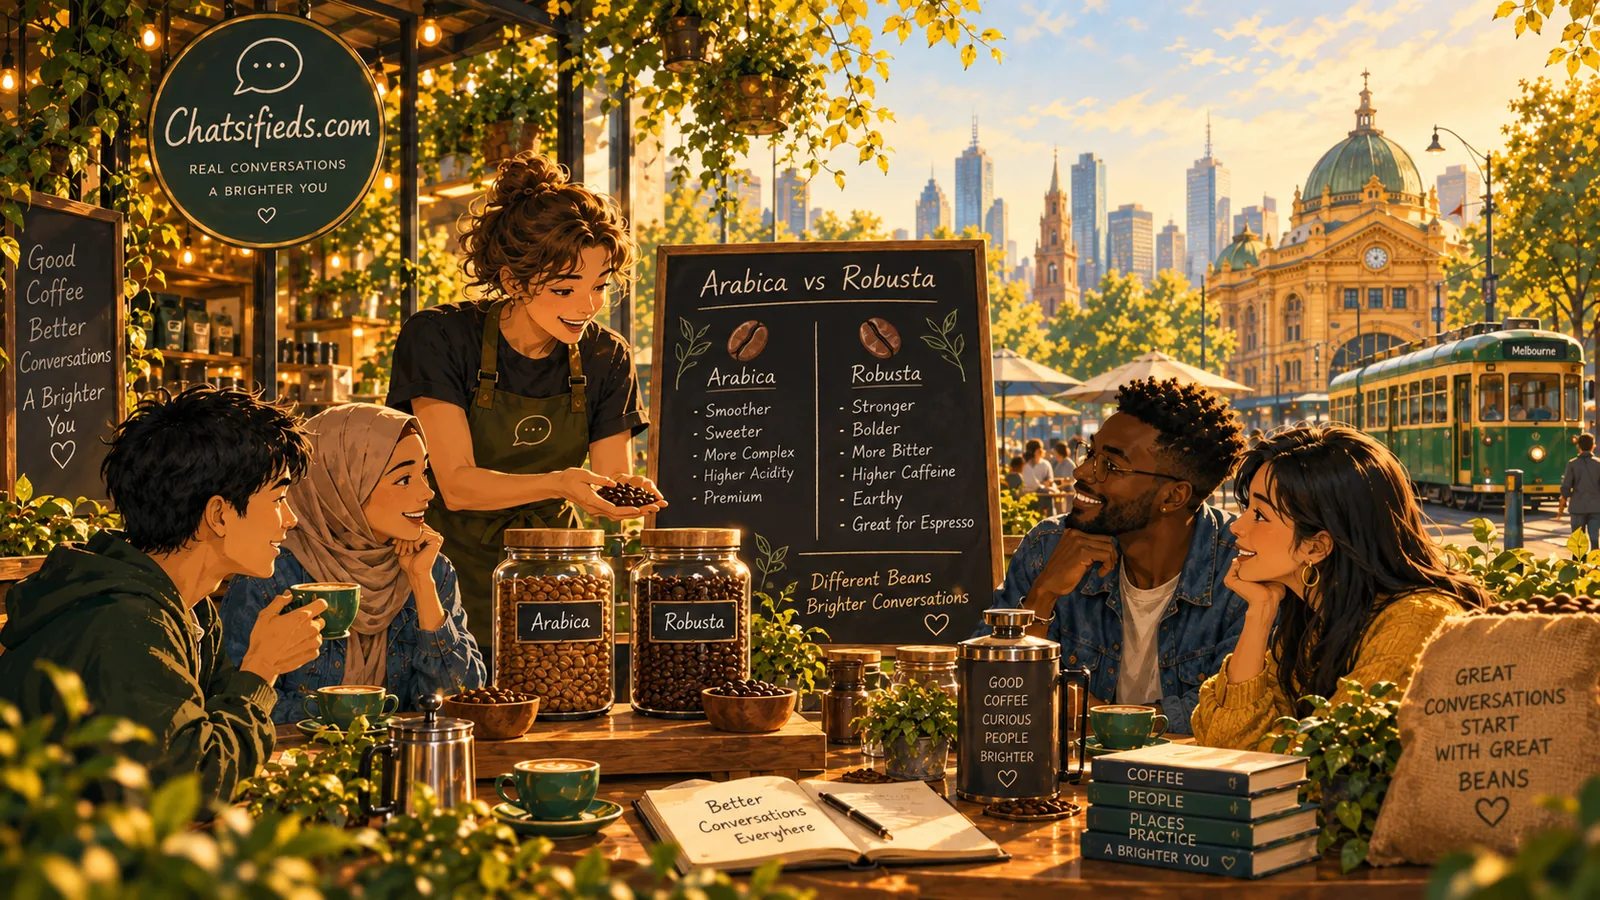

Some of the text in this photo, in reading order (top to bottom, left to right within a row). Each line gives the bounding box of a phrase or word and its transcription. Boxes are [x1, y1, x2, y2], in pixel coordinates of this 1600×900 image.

[164, 104, 371, 148] Chatsifieds.com
[189, 158, 346, 175] REAL CONVERSATIONS
[208, 182, 327, 197] A BRIGHTER YOU
[27, 244, 76, 273] Good
[700, 264, 936, 297] Arabica vs Robusta
[26, 278, 84, 306] Coffee
[29, 317, 86, 343] Better
[1511, 345, 1557, 356] Melbourne
[20, 347, 112, 374] Conversations
[707, 368, 776, 387] Arabica
[851, 364, 922, 383] Robusta
[22, 384, 105, 413] A Brighter
[705, 402, 771, 418] Smoother
[852, 399, 915, 418] Stronger
[47, 415, 76, 438] You
[705, 425, 763, 440] Sweeter
[852, 421, 901, 437] Bolder
[704, 446, 795, 464] More Complex
[852, 443, 933, 458] More Bitter
[703, 466, 794, 486] Higher Acidity
[852, 464, 956, 486] Higher Caffeine
[703, 490, 763, 504] Premium
[853, 491, 904, 510] Earthy
[852, 516, 974, 534] Great for Espresso
[811, 569, 932, 591] Different Beans
[806, 591, 969, 619] Brighter Conversations
[531, 611, 591, 632] Arabica
[664, 612, 725, 631] Robusta
[988, 676, 1024, 689] GOOD
[1456, 664, 1517, 686] GREAT
[984, 694, 1028, 707] COFFEE
[1424, 688, 1566, 716] CONVERSATIONS
[982, 713, 1032, 726] CURIOUS
[1461, 716, 1520, 736] START
[985, 731, 1029, 744] PEOPLE
[980, 750, 1034, 762] BRIGHTER
[1435, 739, 1553, 762] WITH GREAT
[1127, 767, 1184, 786] COFFEE
[1459, 769, 1529, 792] BEANS
[705, 796, 763, 814] Better
[1128, 790, 1184, 808] PEOPLE
[699, 807, 807, 833] Conversations
[1130, 812, 1184, 830] PLACES
[1129, 828, 1196, 847] PRACTICE
[1104, 843, 1209, 867] A BRIGHTER YOU
